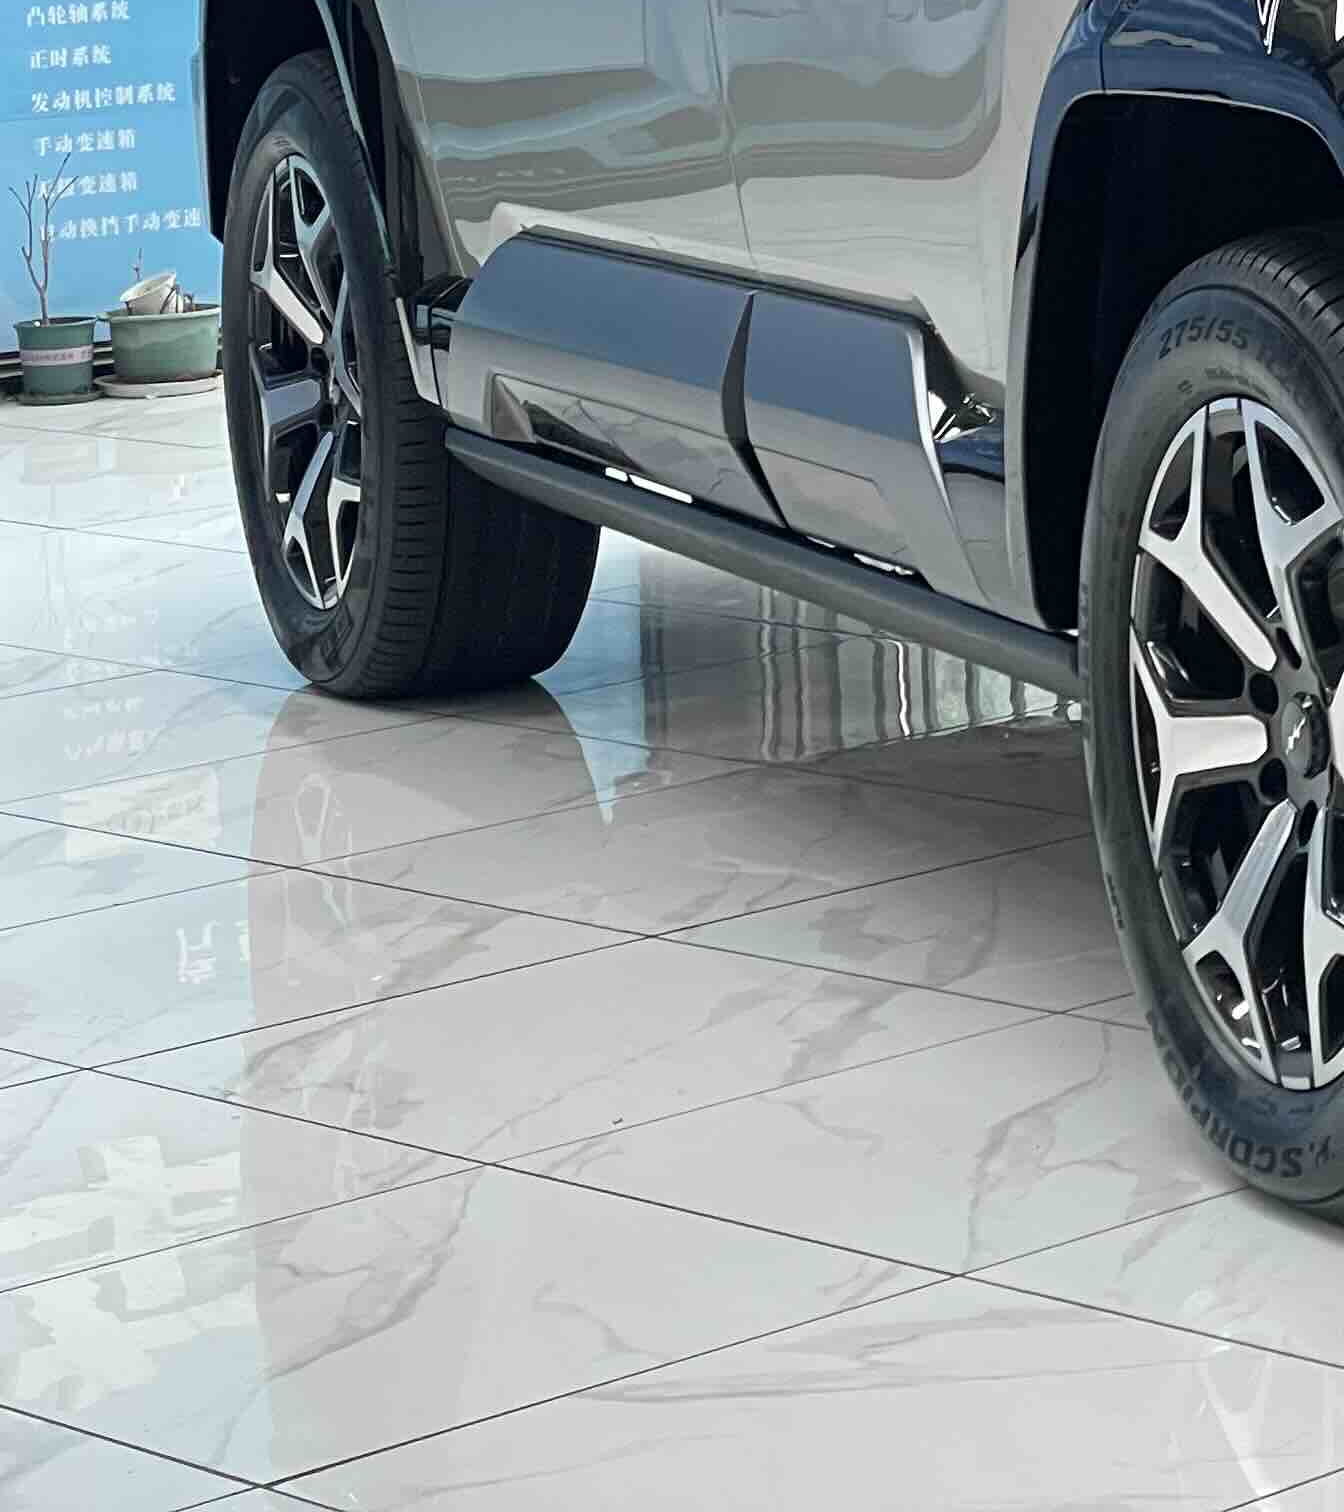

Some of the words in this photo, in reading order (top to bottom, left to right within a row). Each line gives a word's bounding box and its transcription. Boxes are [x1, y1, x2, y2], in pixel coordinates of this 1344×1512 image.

[26, 0, 130, 27] 凸轮轴系统
[30, 45, 112, 70] 正时系统
[32, 82, 176, 113] 发动机控制系统
[36, 129, 136, 156] 手动变速箱
